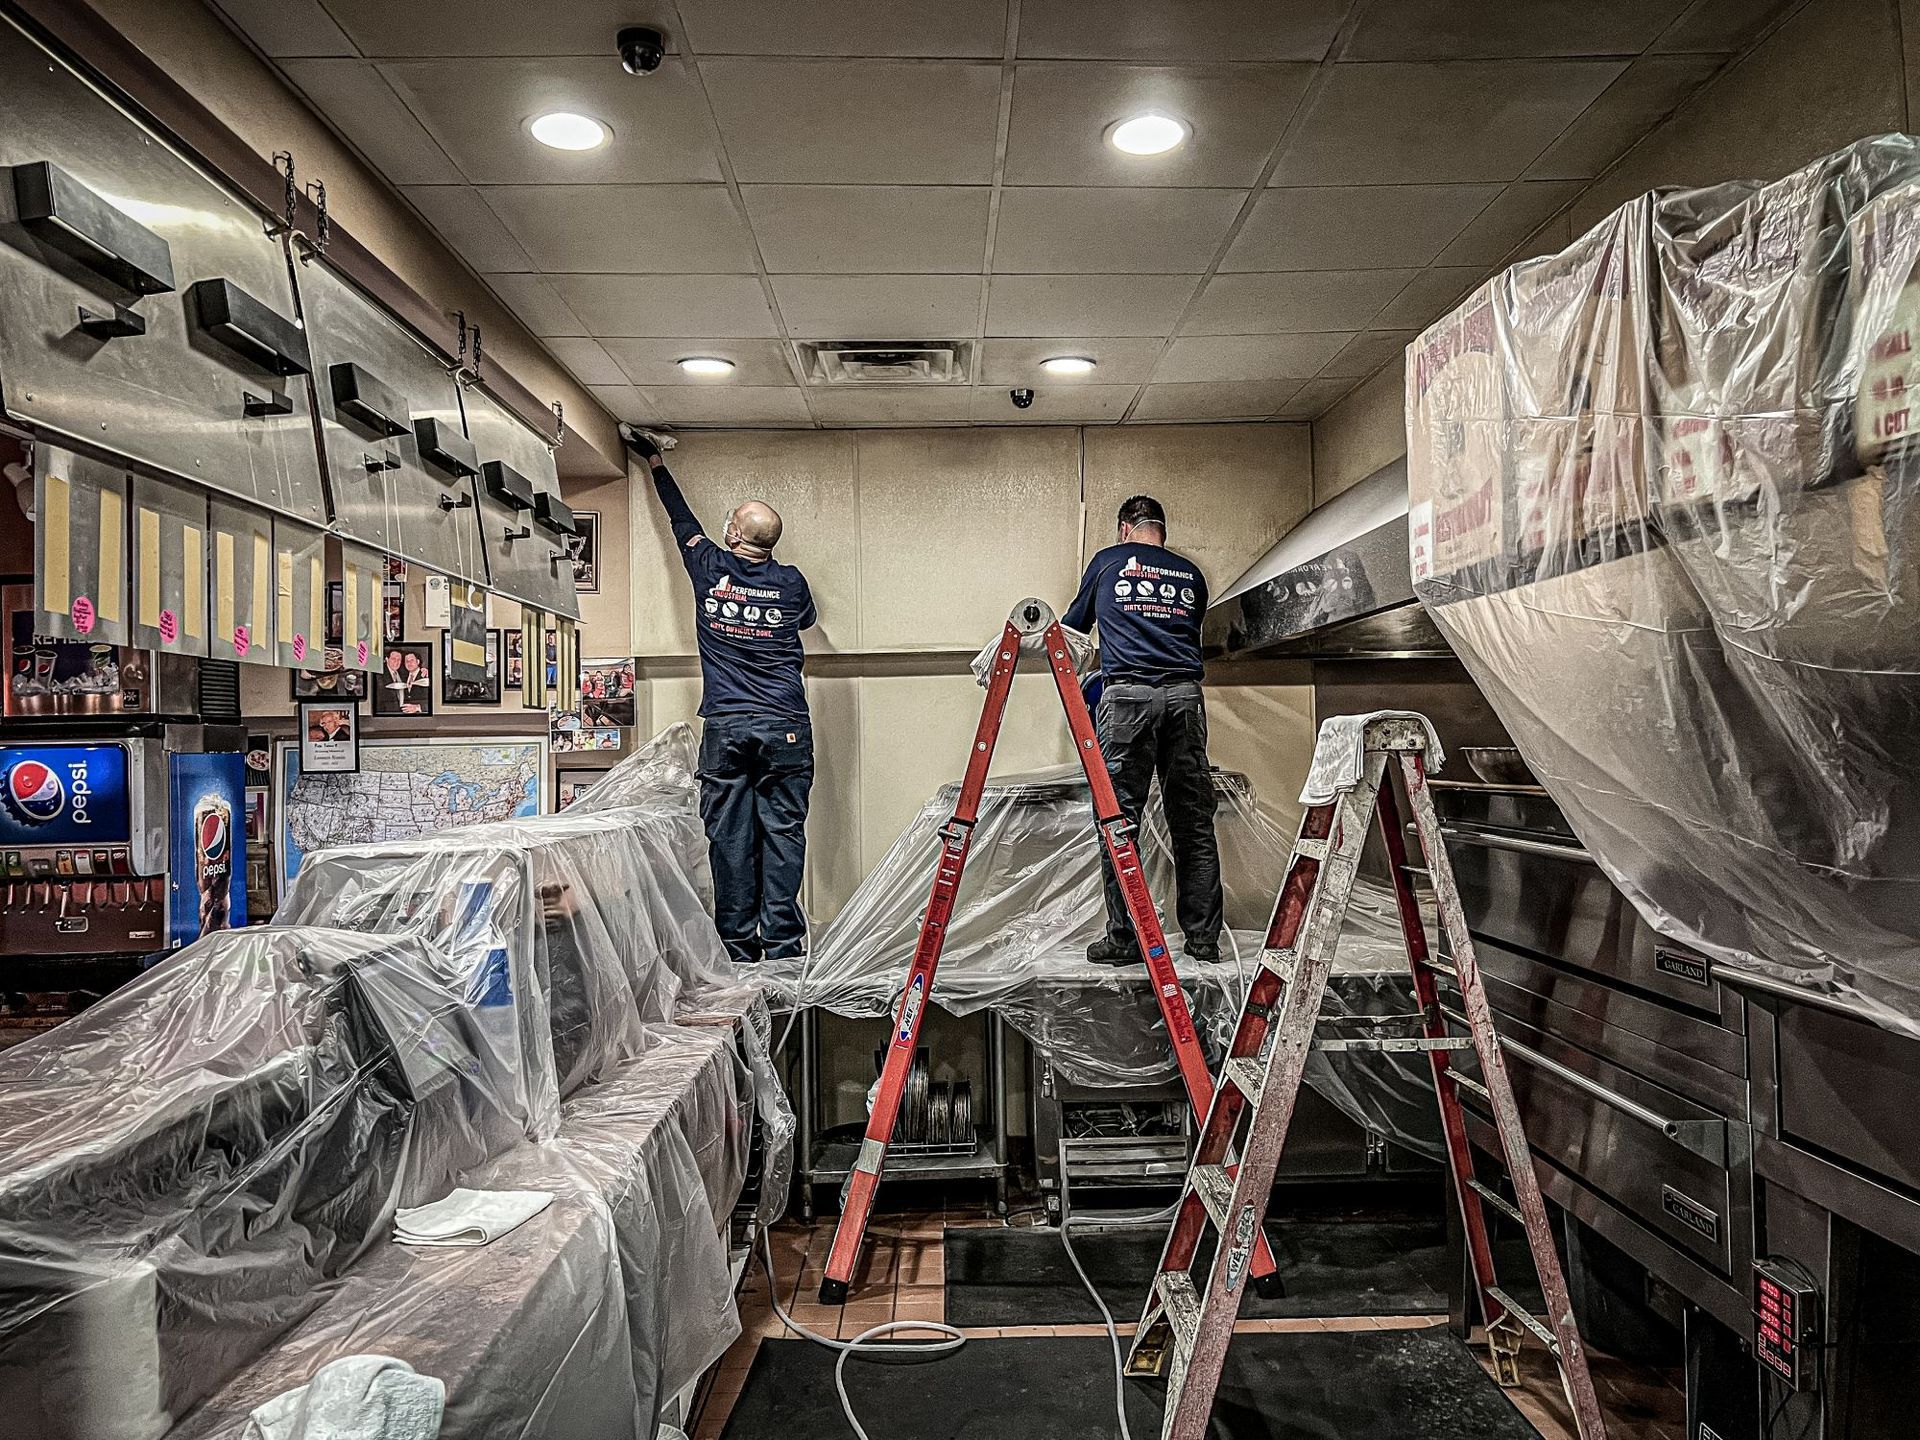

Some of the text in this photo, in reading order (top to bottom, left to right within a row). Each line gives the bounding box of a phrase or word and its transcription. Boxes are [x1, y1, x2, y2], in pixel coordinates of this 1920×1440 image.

[1884, 408, 1910, 436] CUT
[1125, 570, 1162, 580] INDUSTRIAL
[1142, 565, 1194, 580] PERFORMANCE
[714, 590, 747, 602] INDUSTRIAL
[731, 585, 781, 599] PERFORMANCE
[1664, 960, 1703, 978] GARLAND
[1672, 1203, 1713, 1233] GARLAND
